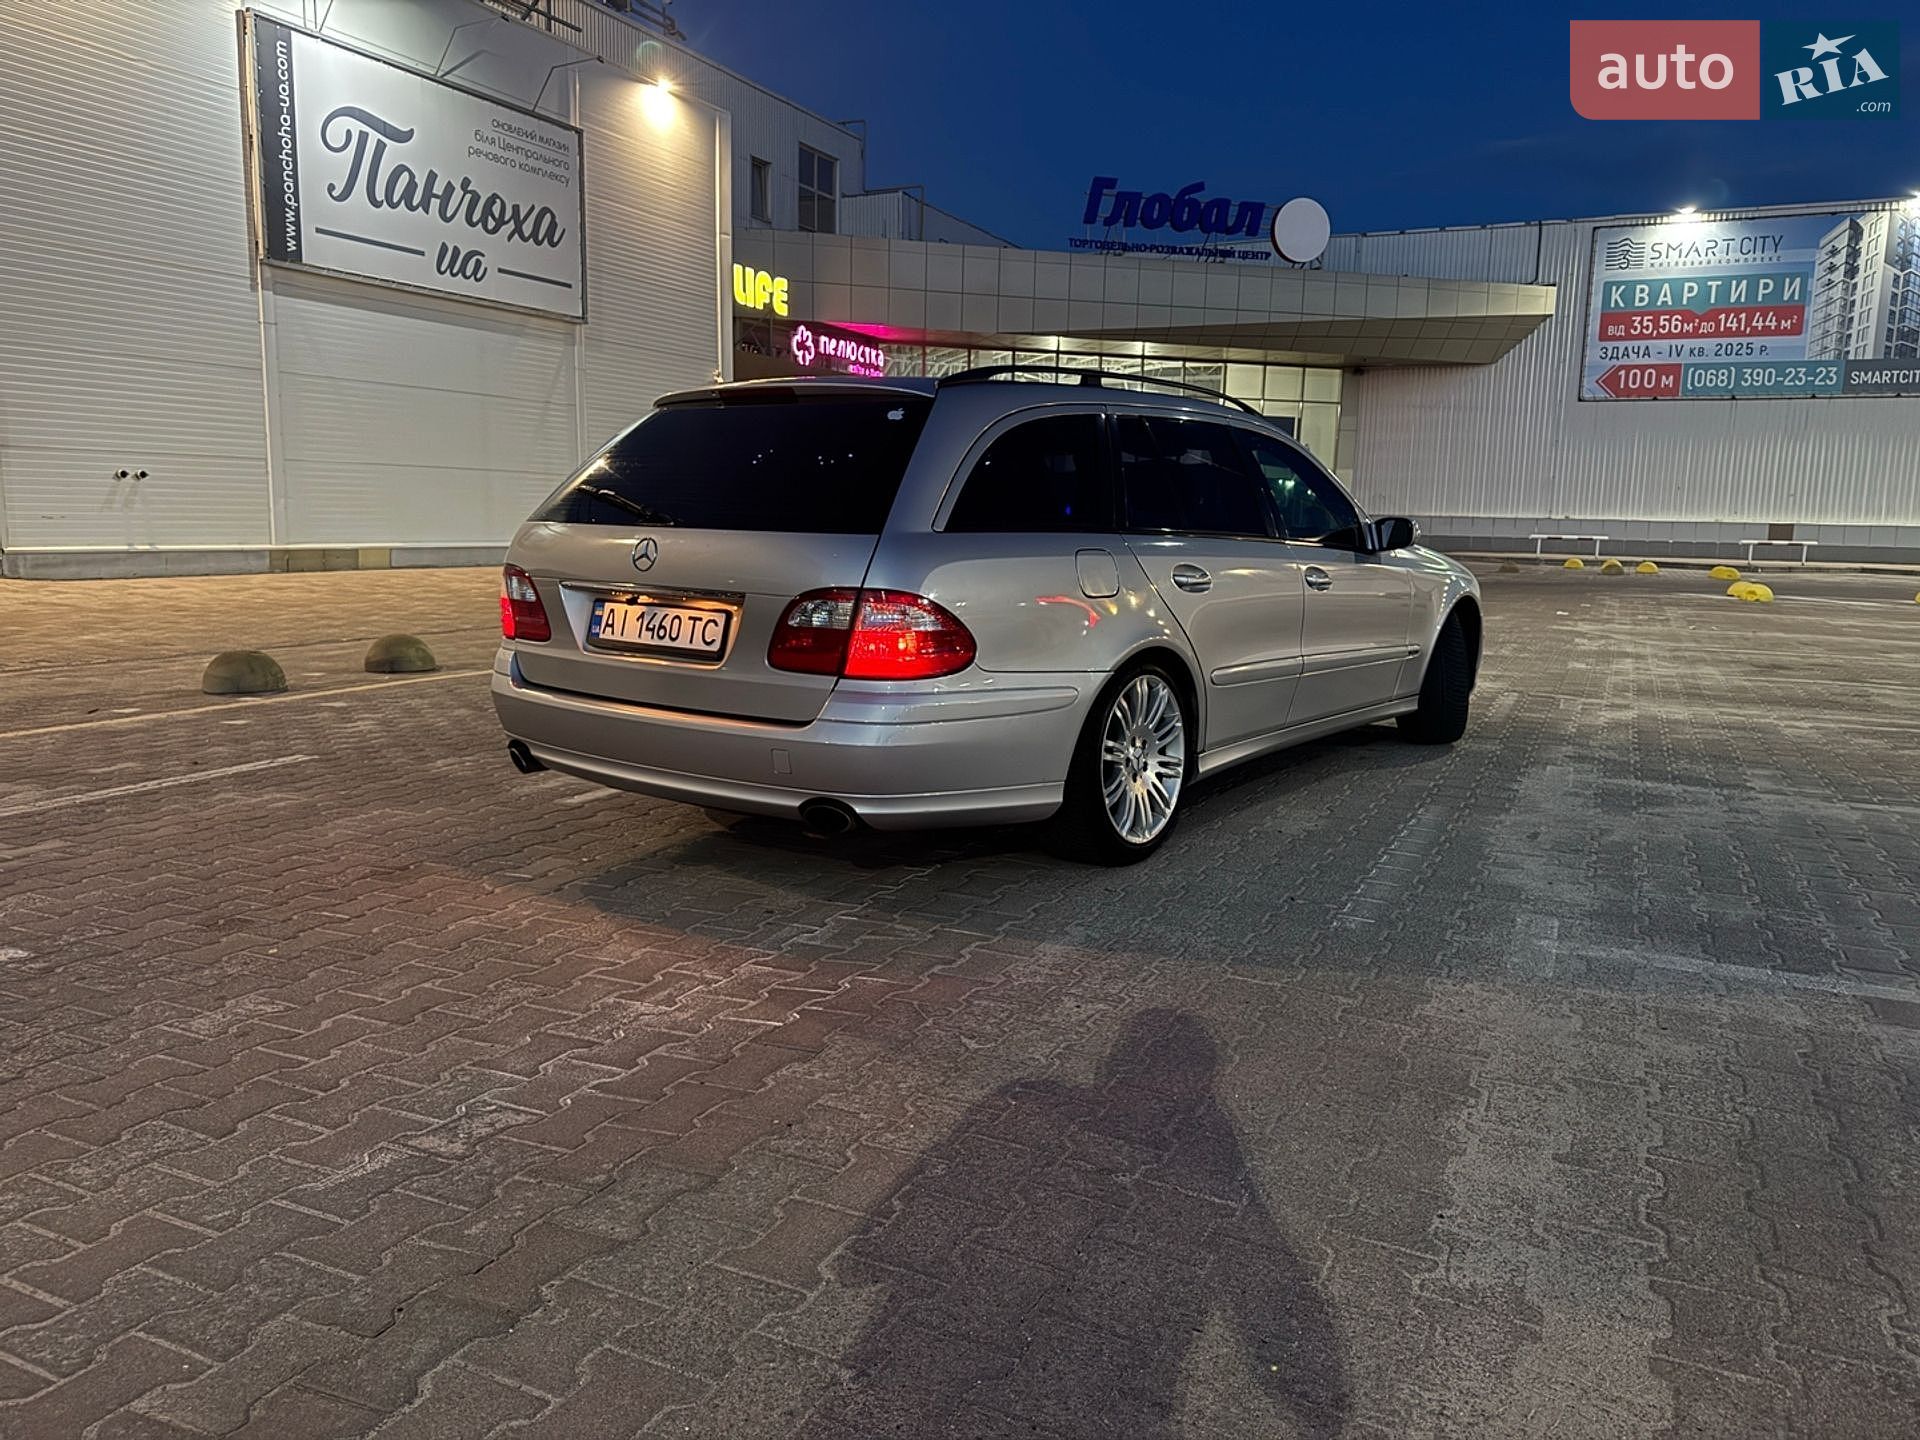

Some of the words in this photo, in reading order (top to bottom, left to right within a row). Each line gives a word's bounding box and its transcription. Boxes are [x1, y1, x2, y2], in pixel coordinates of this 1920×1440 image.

[276, 40, 298, 252] www.panchoha-ua.com
[498, 136, 570, 171] Центрального
[320, 106, 566, 248] Панчоха
[468, 146, 517, 169] речового
[519, 162, 571, 188] комплексу
[1083, 175, 1266, 238] Глобал
[1610, 276, 1802, 309] КВАРТИРИ
[1718, 311, 1778, 333] 141,44
[1599, 344, 1651, 361] ЗДАЧА
[1668, 344, 1685, 358] IV
[1714, 342, 1754, 357] 2025
[1617, 368, 1657, 389] 100
[1687, 366, 1736, 390] (068)
[1741, 366, 1838, 387] 390-23-23
[602, 608, 627, 637] AI
[636, 611, 682, 642] 1460
[688, 616, 719, 646] TC
